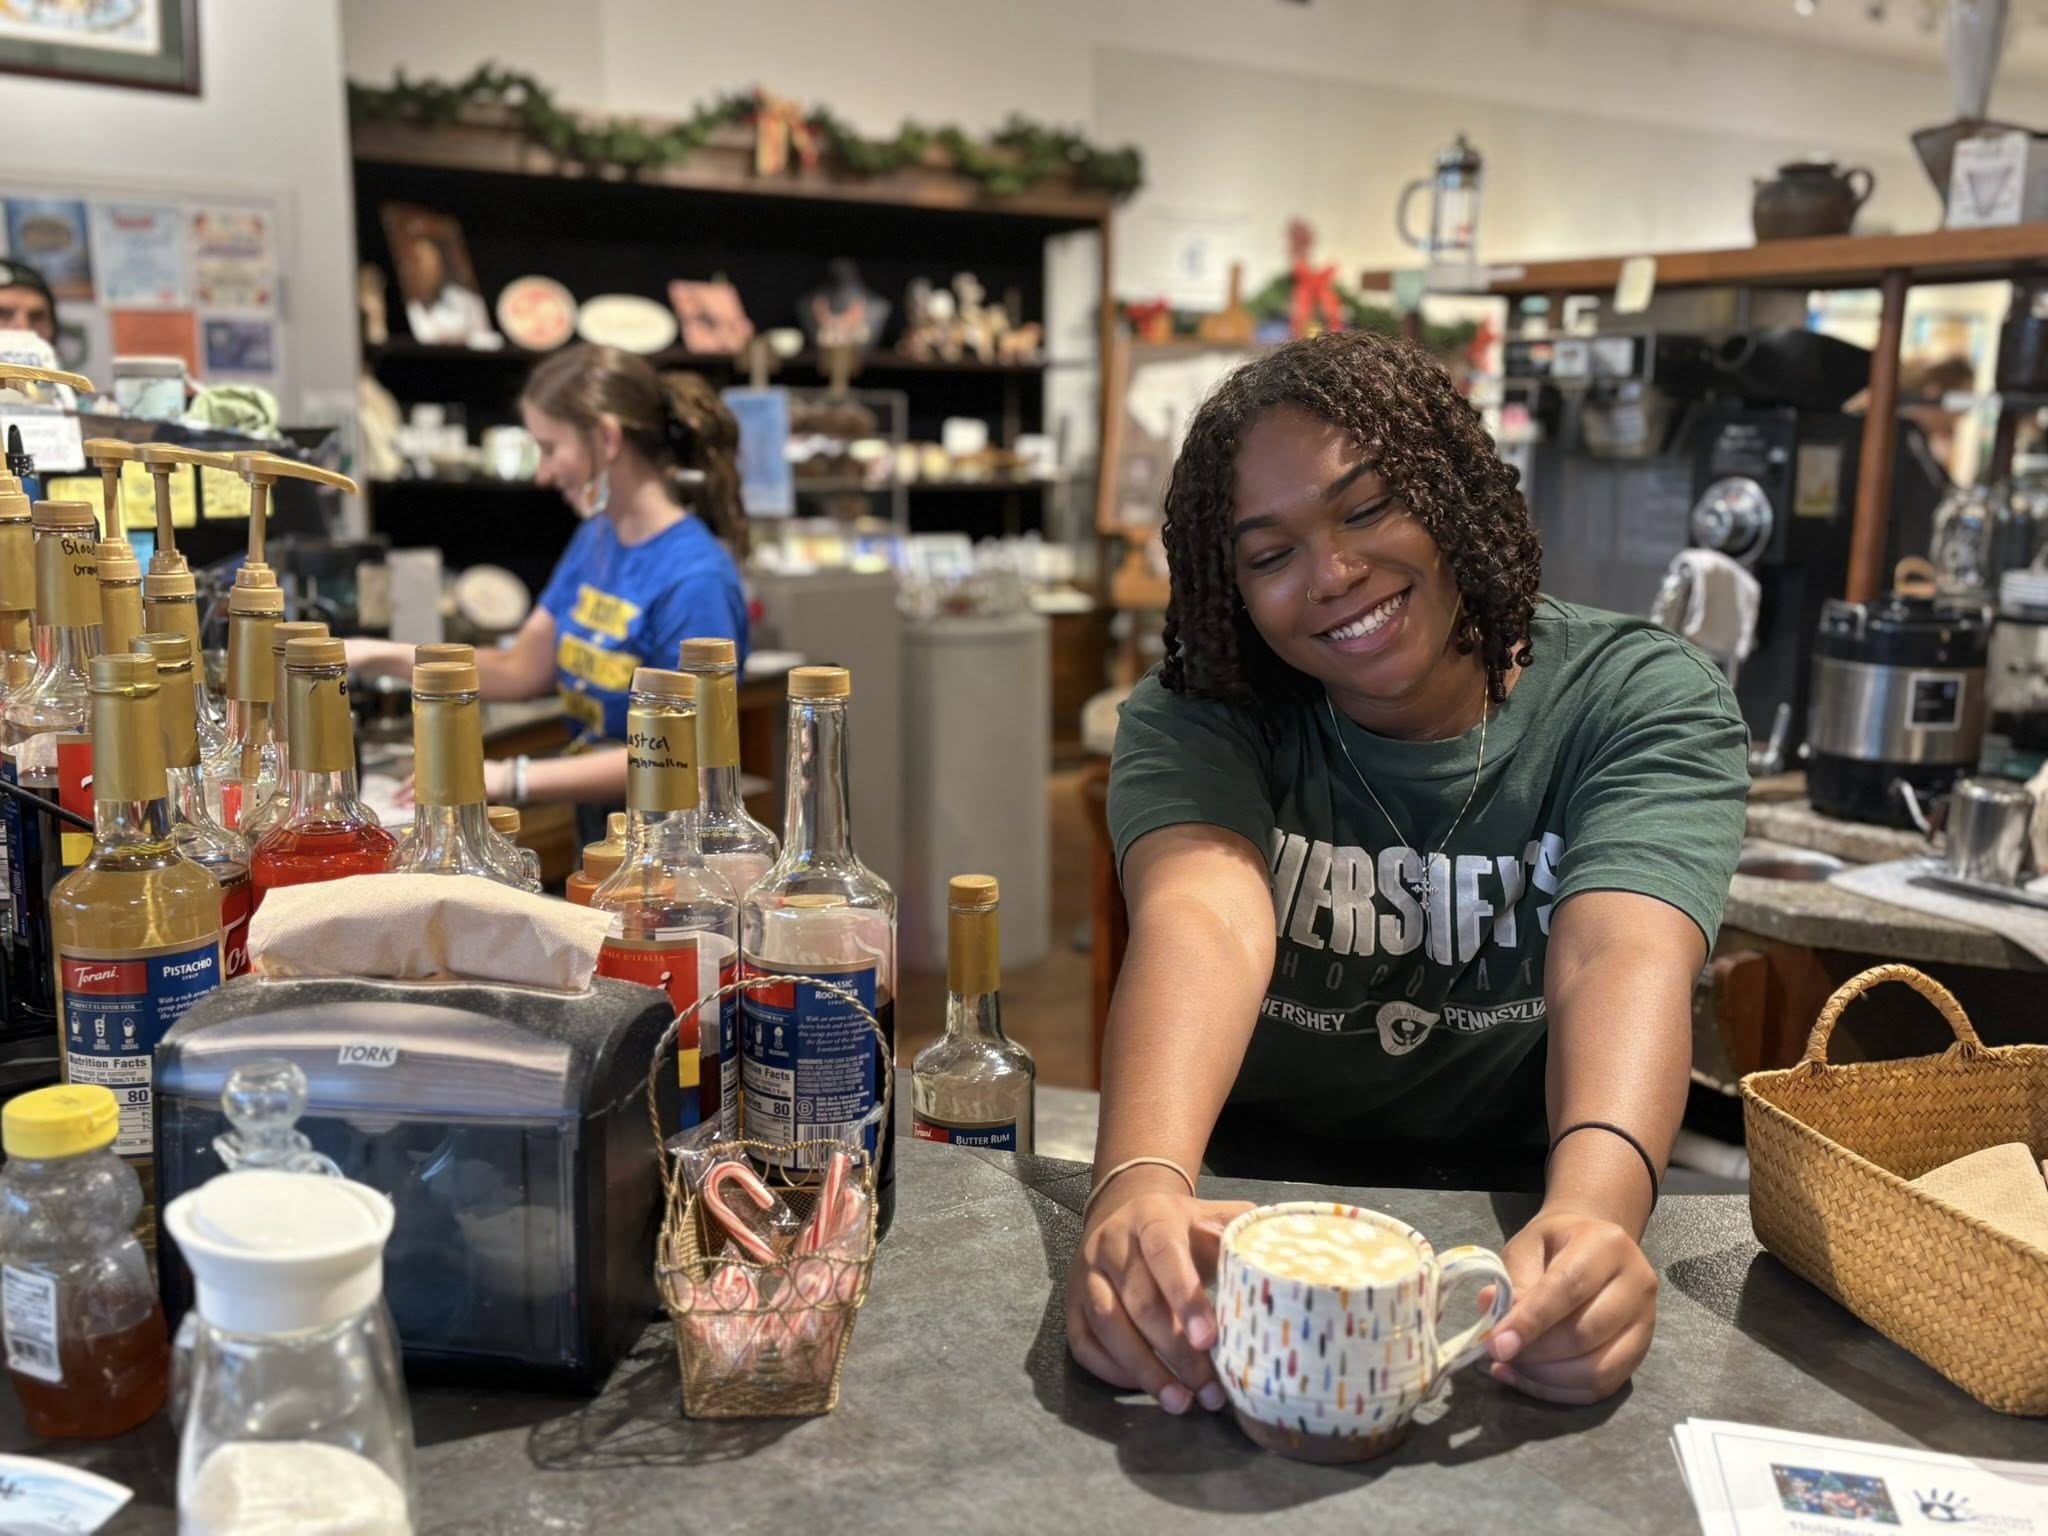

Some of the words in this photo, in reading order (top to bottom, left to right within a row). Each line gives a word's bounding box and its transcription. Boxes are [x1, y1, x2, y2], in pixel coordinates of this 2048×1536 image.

[162, 957, 212, 978] PISTACHIO
[1261, 998, 1345, 1032] HERSHEY
[342, 1046, 394, 1062] TORK
[69, 1055, 109, 1069] Nutrition
[113, 1058, 147, 1069] Facts
[764, 1067, 791, 1082] Facts
[127, 1089, 149, 1103] 80
[773, 1102, 790, 1116] 80
[956, 1135, 989, 1146] BUTTER
[990, 1133, 1010, 1144] RUM
